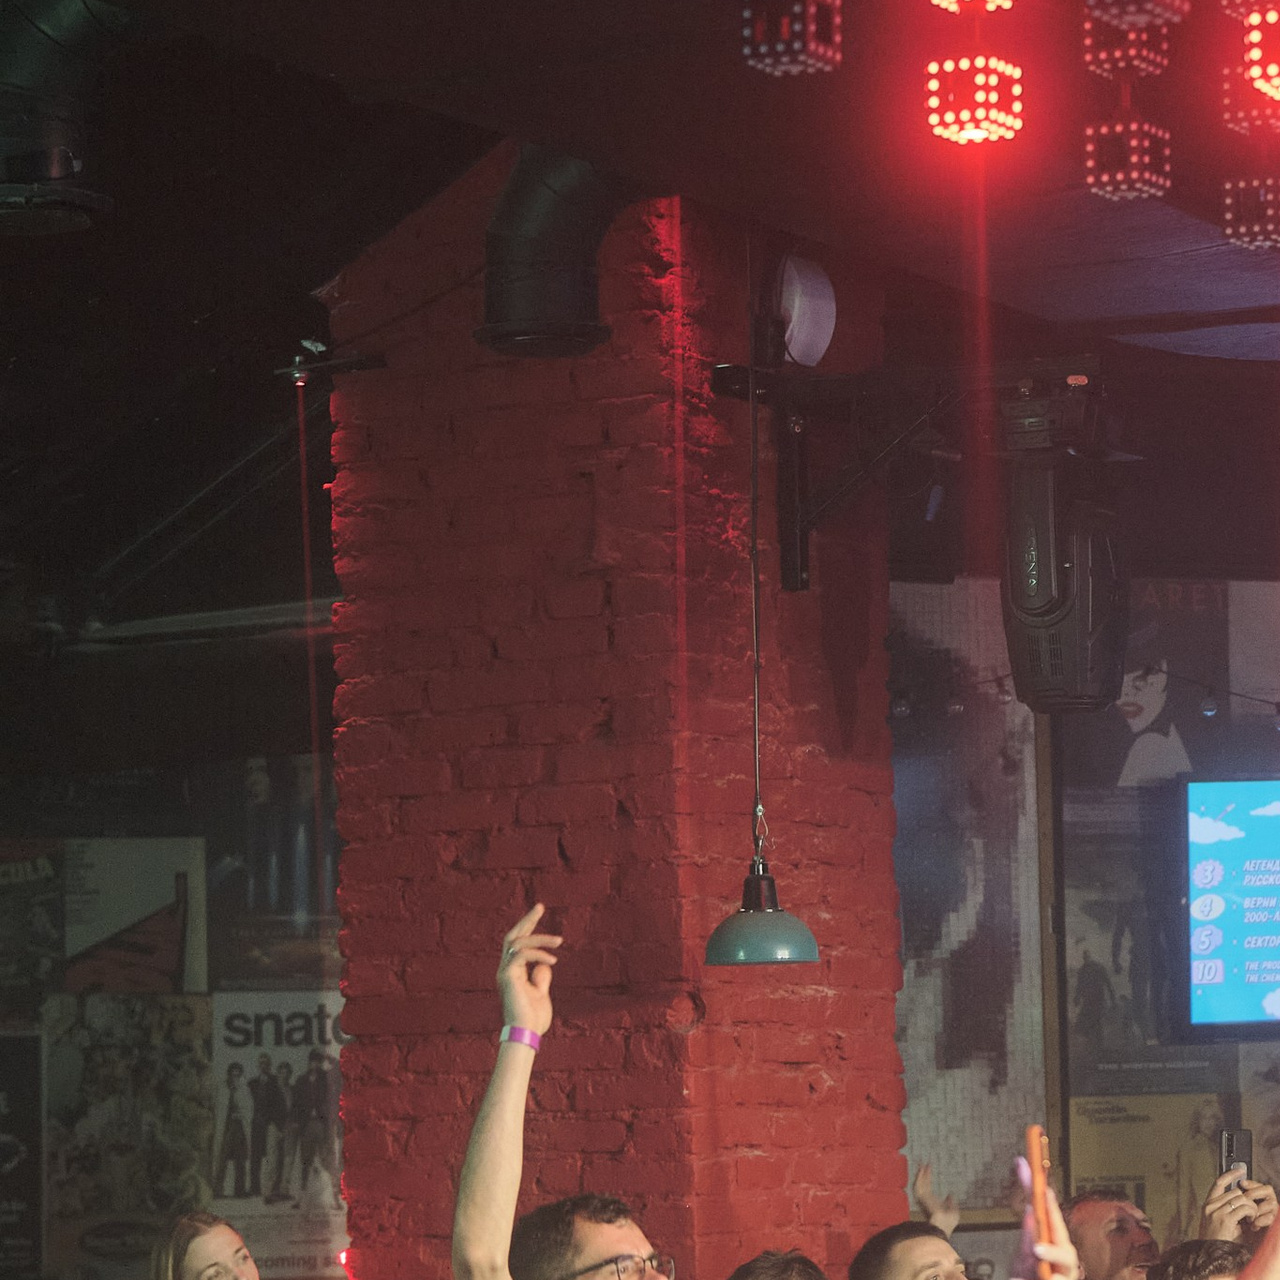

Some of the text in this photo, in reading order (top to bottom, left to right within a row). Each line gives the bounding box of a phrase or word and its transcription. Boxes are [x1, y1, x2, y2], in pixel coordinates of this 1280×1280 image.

[1201, 862, 1215, 883] 3
[1200, 897, 1213, 917] 4
[1243, 897, 1277, 910] ВЕРНИ
[1199, 929, 1213, 951] 5
[1199, 962, 1217, 983] 10
[1244, 961, 1260, 971] THE
[1244, 973, 1260, 984] THE
